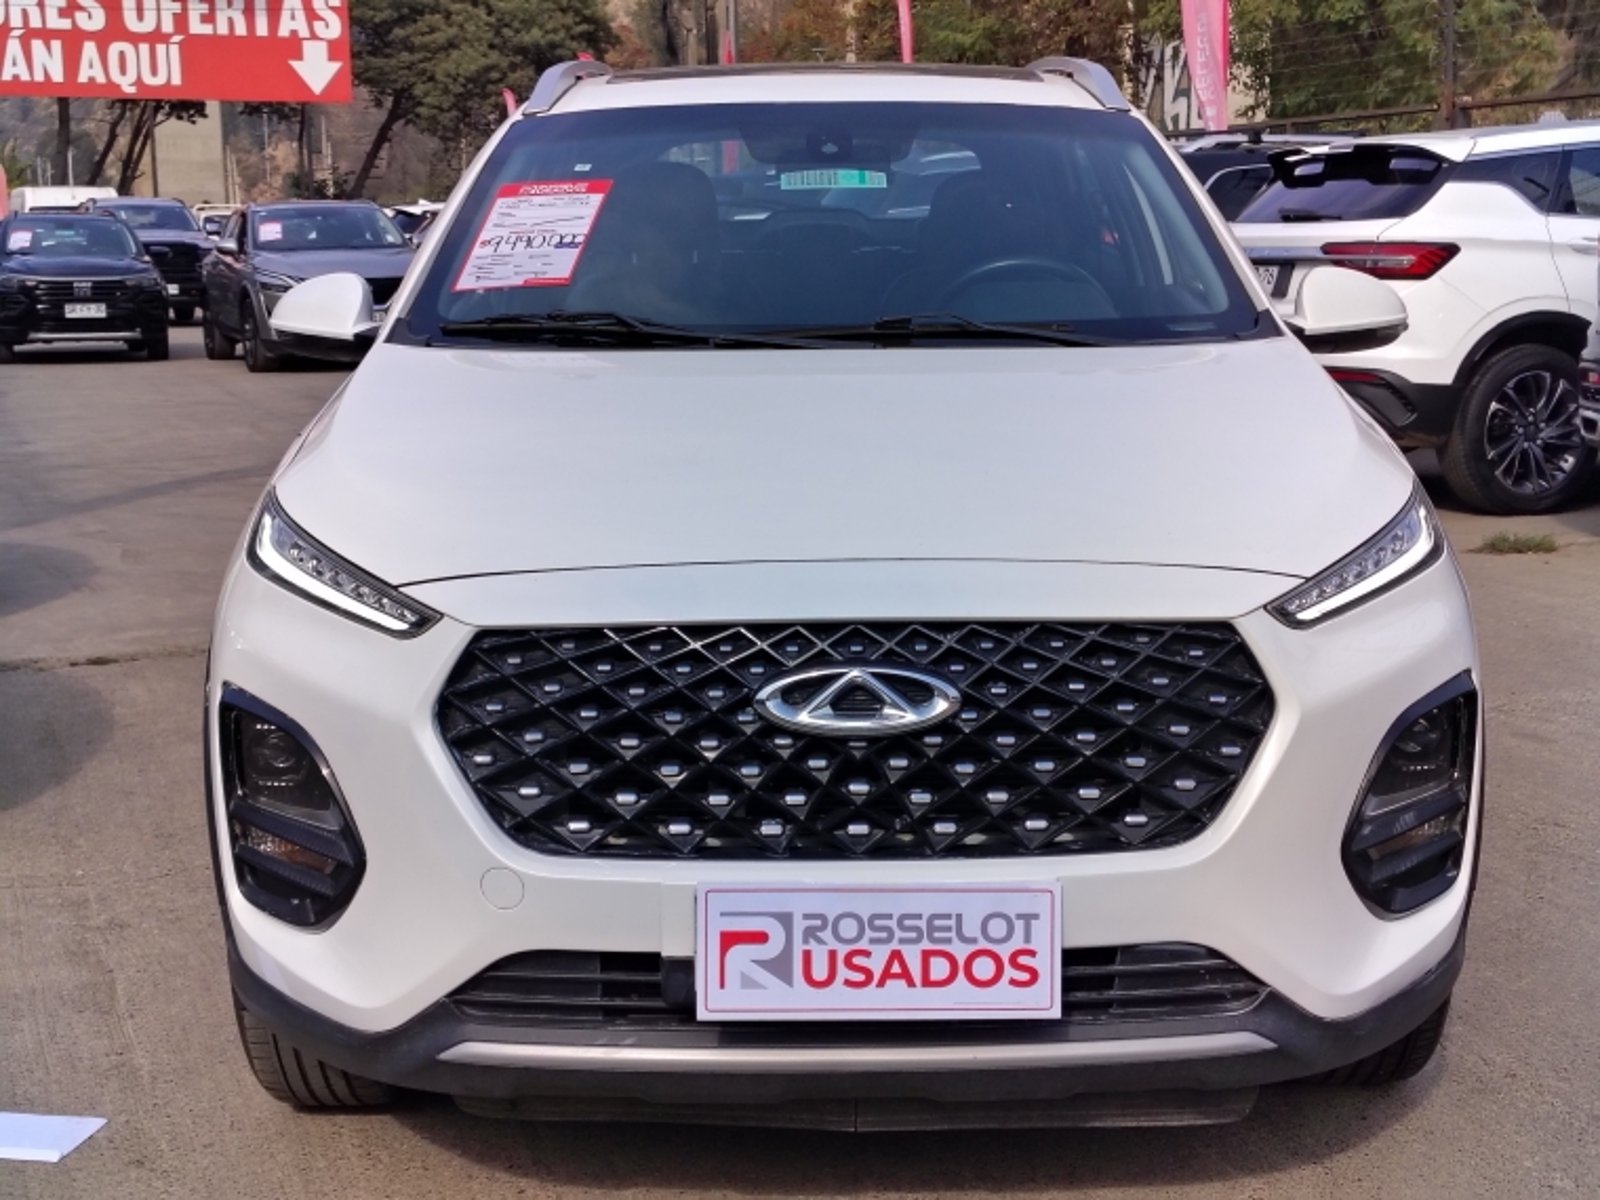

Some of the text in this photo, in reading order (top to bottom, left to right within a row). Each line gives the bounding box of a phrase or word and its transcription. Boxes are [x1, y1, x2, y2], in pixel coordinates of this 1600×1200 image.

[0, 0, 342, 40] RES OFERTAS
[76, 35, 186, 93] AQUÍ
[801, 911, 1040, 945] ROSSELOT
[801, 948, 1041, 990] USADOS
